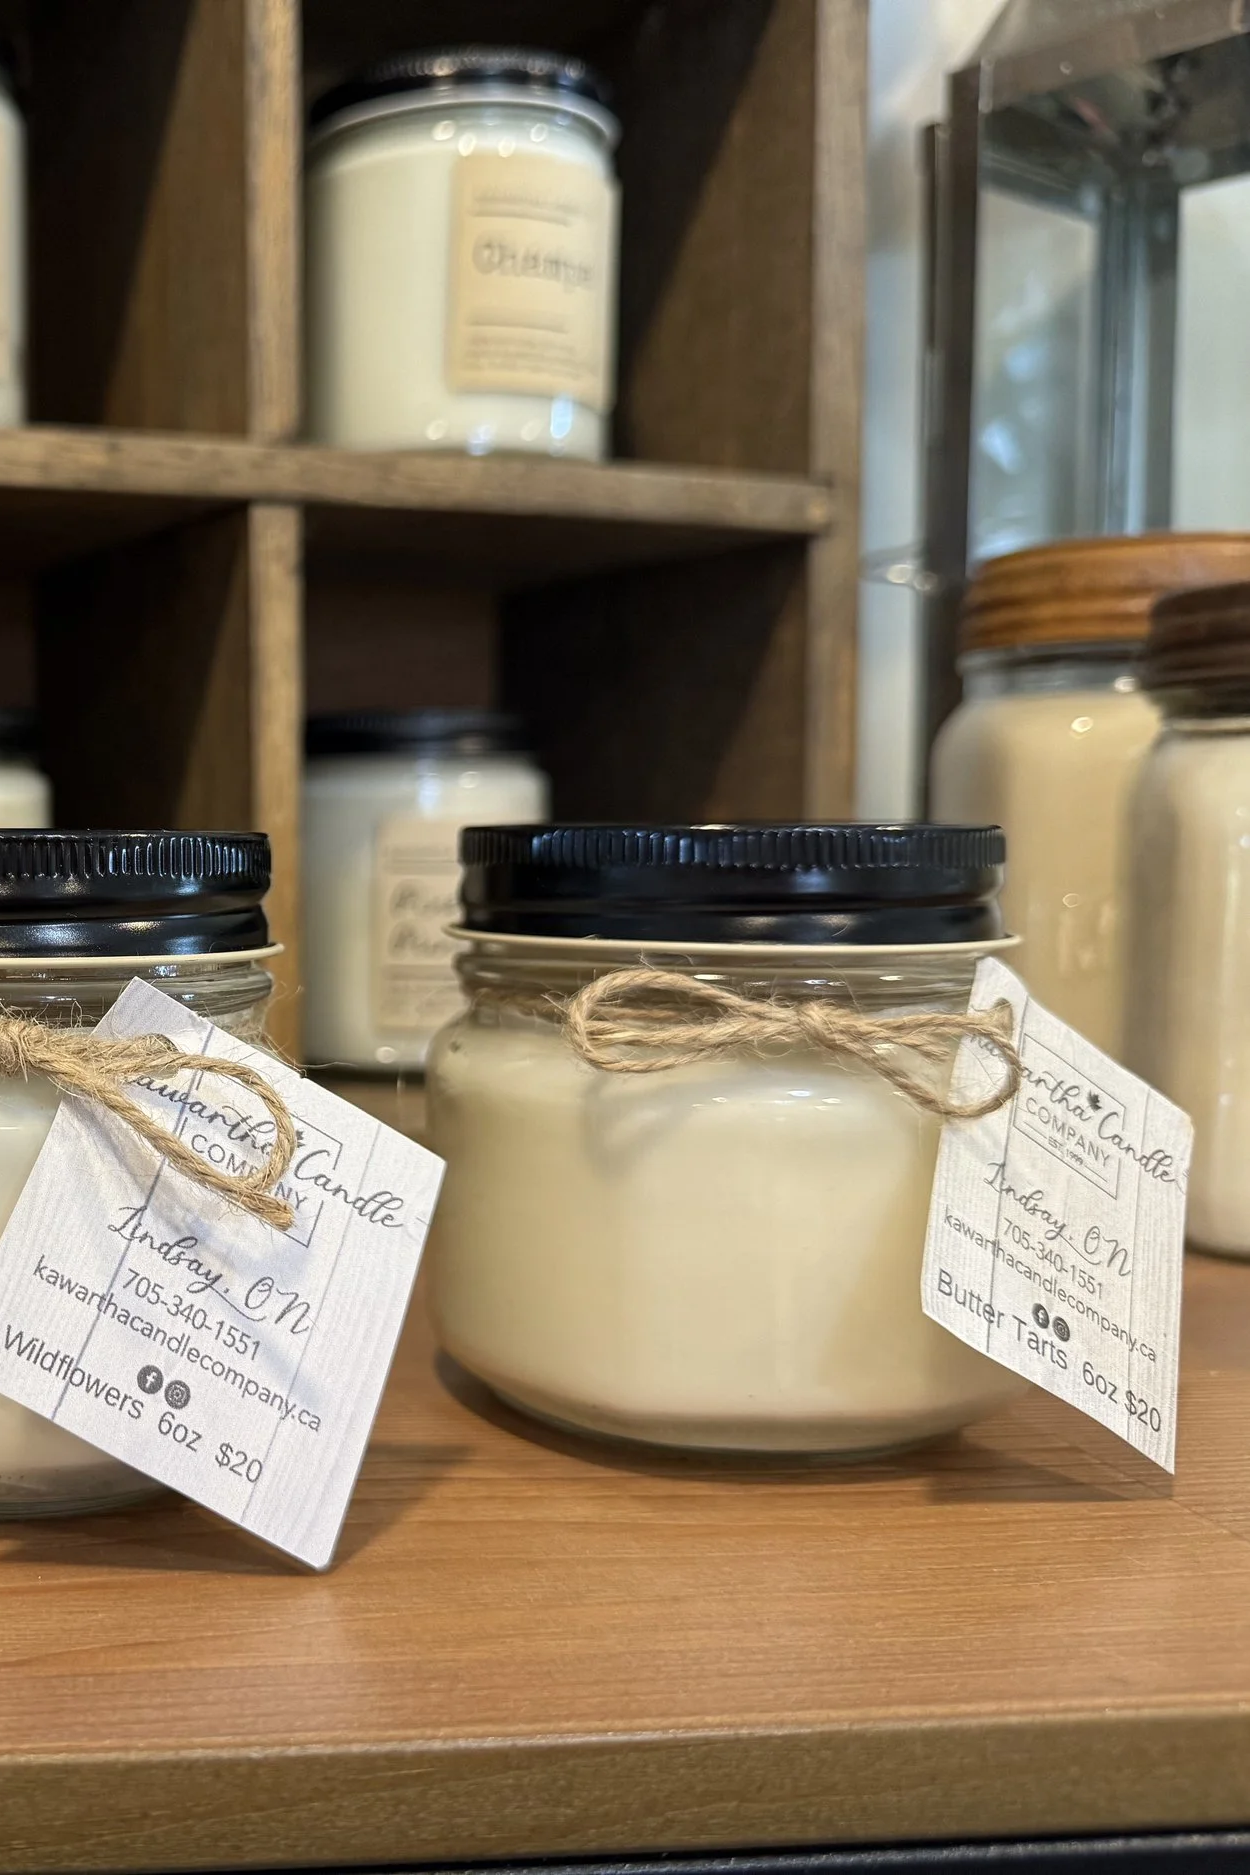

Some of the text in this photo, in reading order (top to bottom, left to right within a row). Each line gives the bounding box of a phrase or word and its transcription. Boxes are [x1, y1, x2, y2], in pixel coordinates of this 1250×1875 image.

[1025, 1096, 1111, 1168] COMPANY
[1097, 1111, 1177, 1184] Candle
[294, 1149, 404, 1228] Candle
[943, 1204, 1157, 1363] kawarthacandlecompany.ca
[1003, 1218, 1103, 1299] 705-340-1551
[1084, 1226, 1131, 1277] ON
[33, 1254, 322, 1432] kawarthacandlecompany.ca
[122, 1268, 261, 1360] 705-340-1551
[244, 1276, 312, 1334] ON
[937, 1268, 1162, 1433] Butter Tarts 6oz $20
[3, 1323, 264, 1484] Wildflowers 6oz $20
